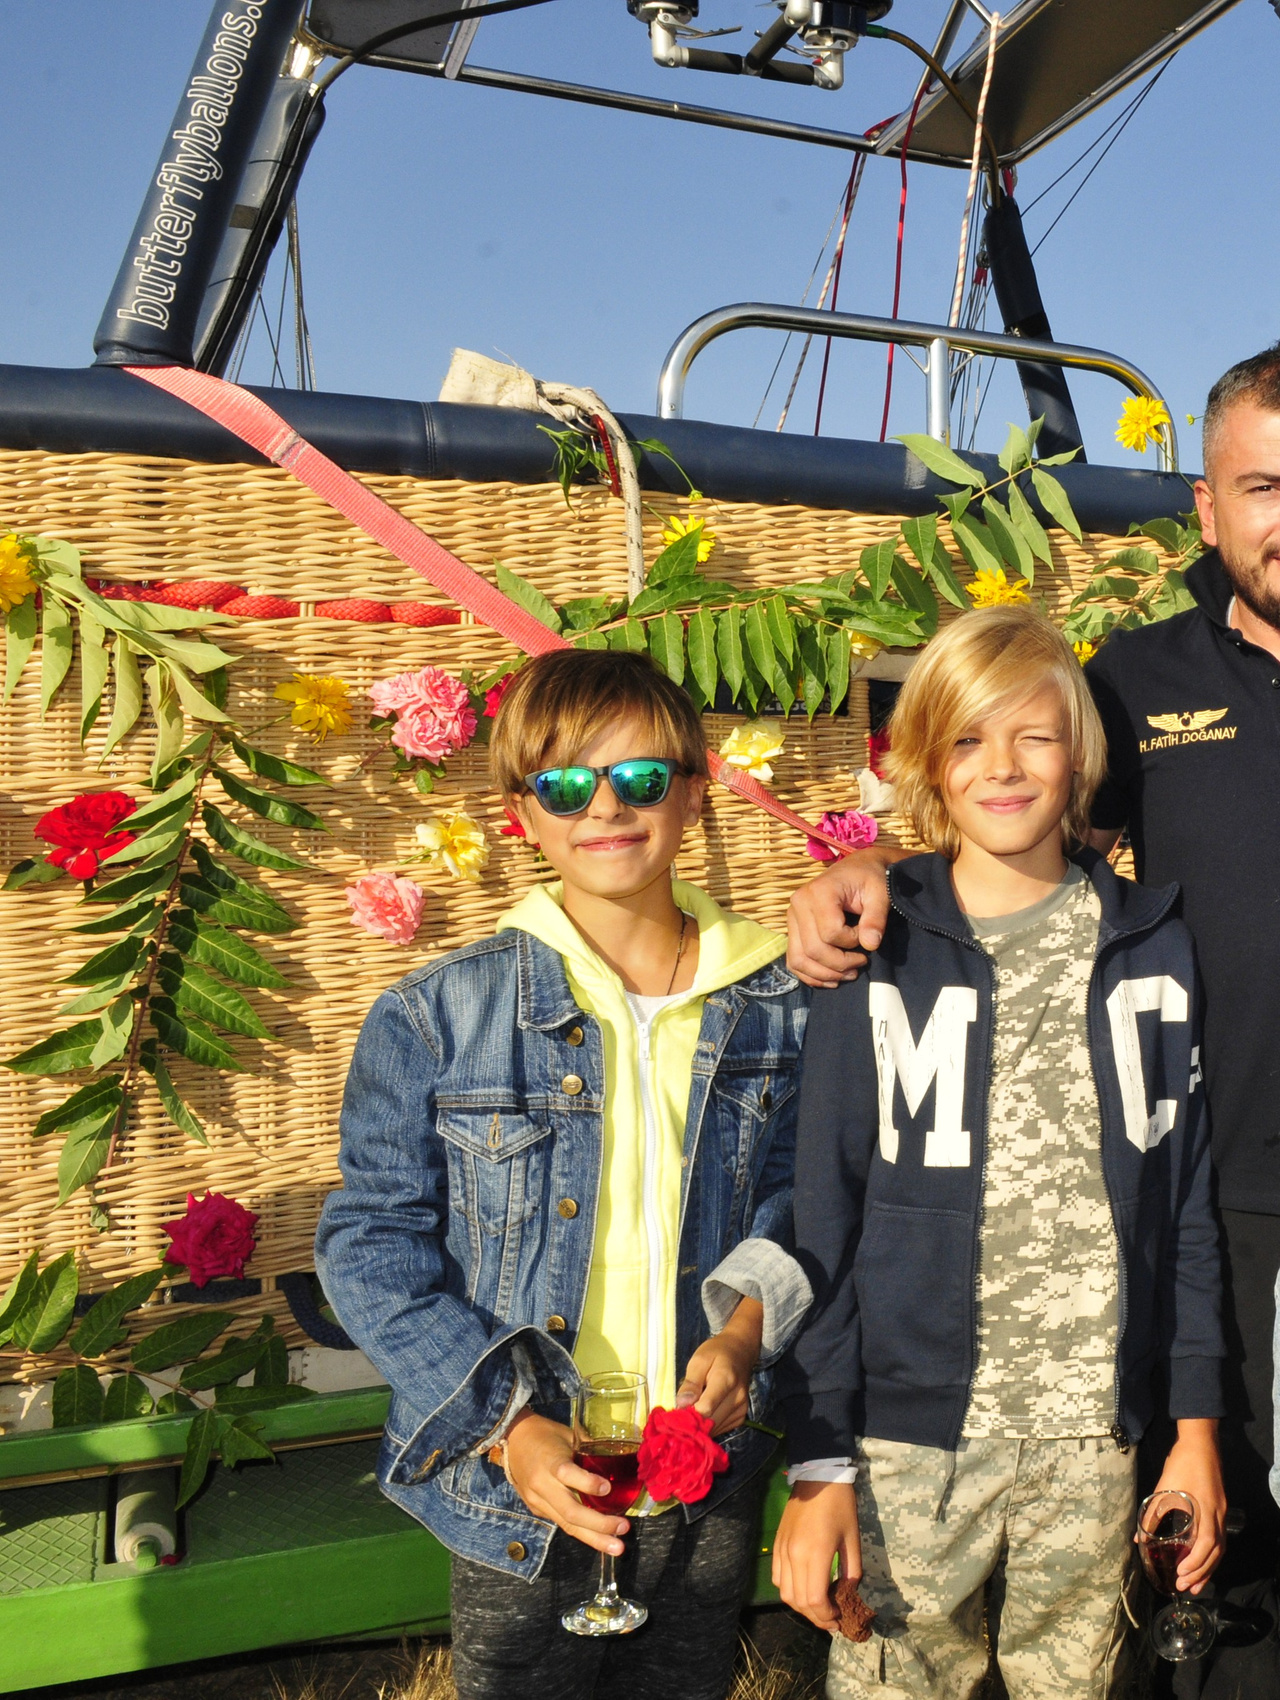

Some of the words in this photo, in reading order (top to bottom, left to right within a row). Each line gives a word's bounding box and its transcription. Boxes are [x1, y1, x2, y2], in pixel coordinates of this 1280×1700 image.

[117, 0, 268, 330] butterflyballons.
[1181, 727, 1237, 744] DOĞANAY
[868, 981, 977, 1167] M
